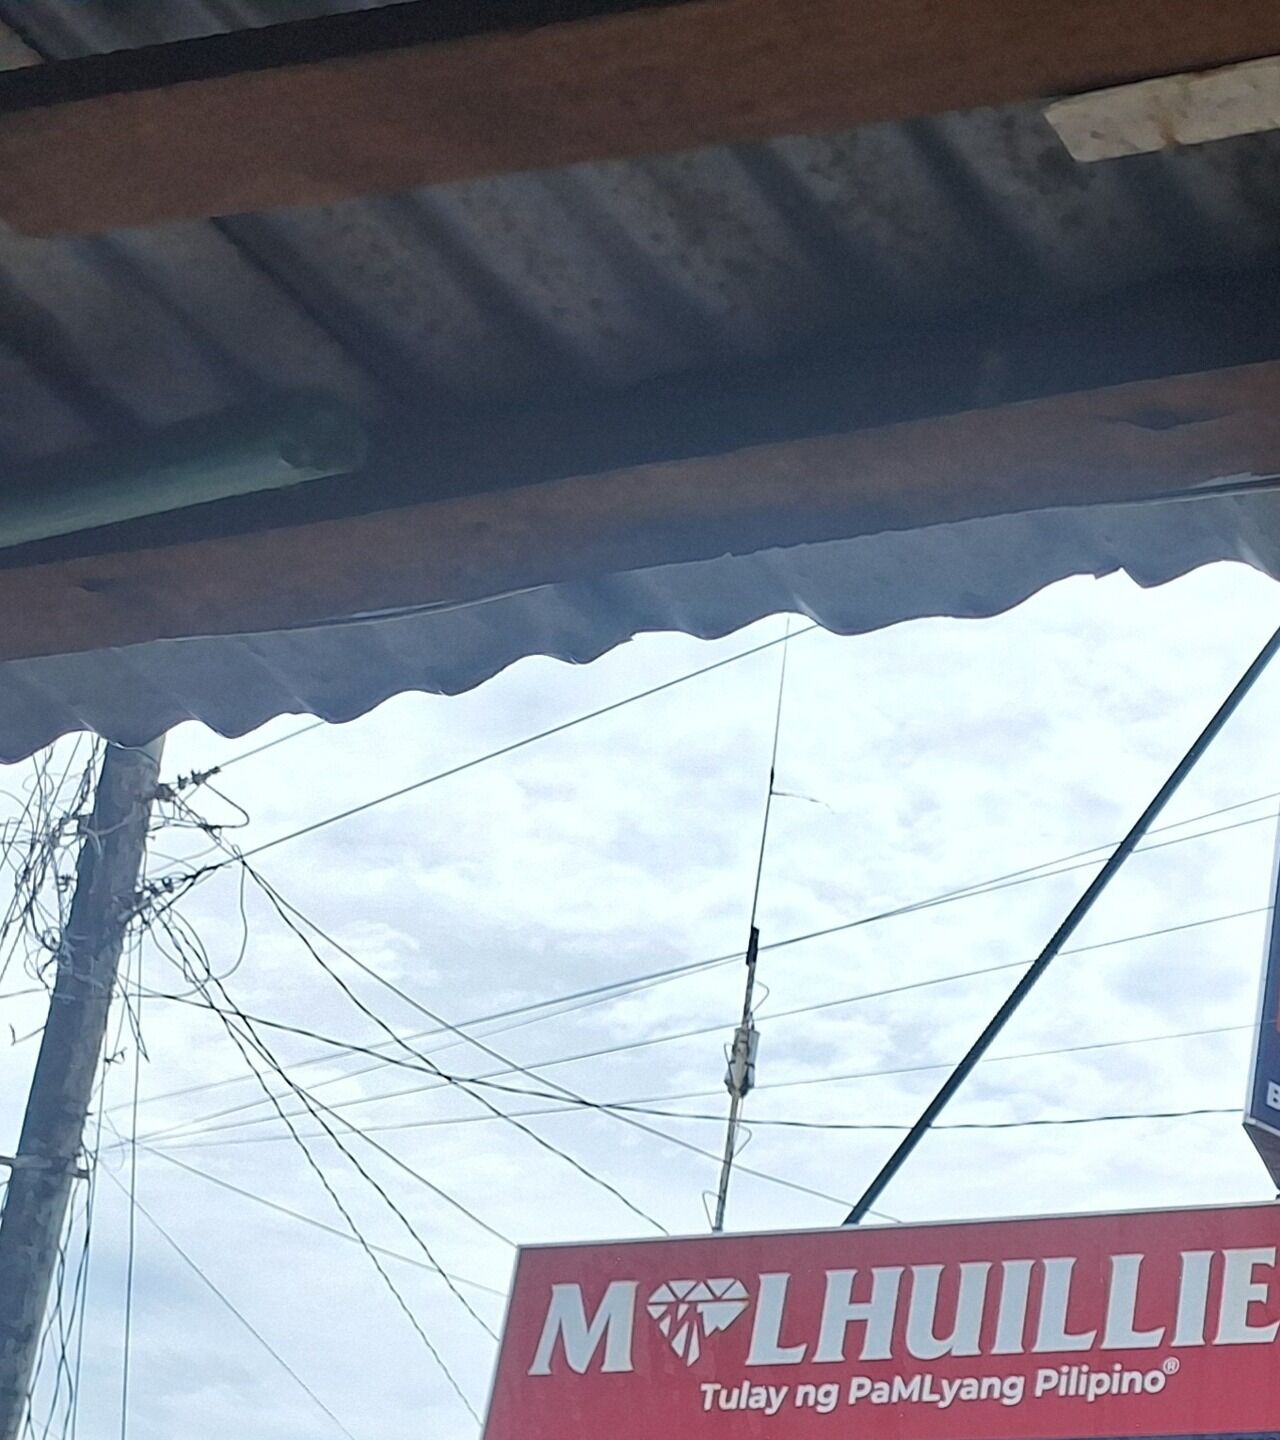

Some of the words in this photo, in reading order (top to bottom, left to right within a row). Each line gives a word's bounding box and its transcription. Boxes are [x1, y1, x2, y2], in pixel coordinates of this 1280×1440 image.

[700, 1380, 788, 1416] Tulay
[795, 1381, 839, 1414] ng
[848, 1370, 1026, 1409] PaMLyang
